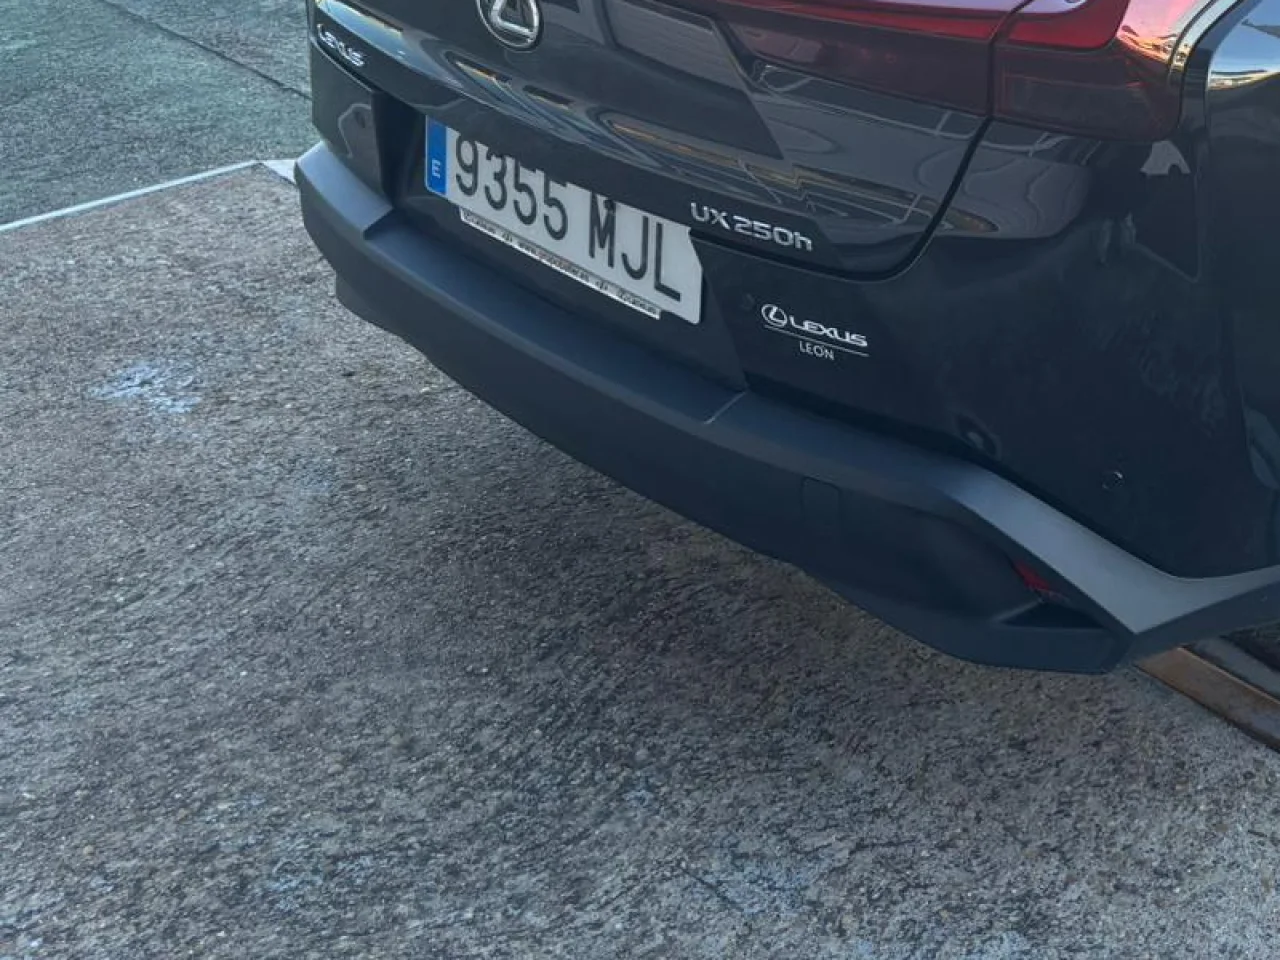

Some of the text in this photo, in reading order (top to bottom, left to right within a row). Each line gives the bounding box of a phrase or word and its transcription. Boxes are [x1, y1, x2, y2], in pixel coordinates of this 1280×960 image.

[317, 23, 364, 66] LEXUS
[431, 158, 441, 179] E
[455, 135, 568, 240] 9355
[589, 191, 681, 302] MJL
[690, 202, 813, 252] UX 250h
[789, 315, 868, 347] LEXUS
[800, 341, 835, 360] LEON
